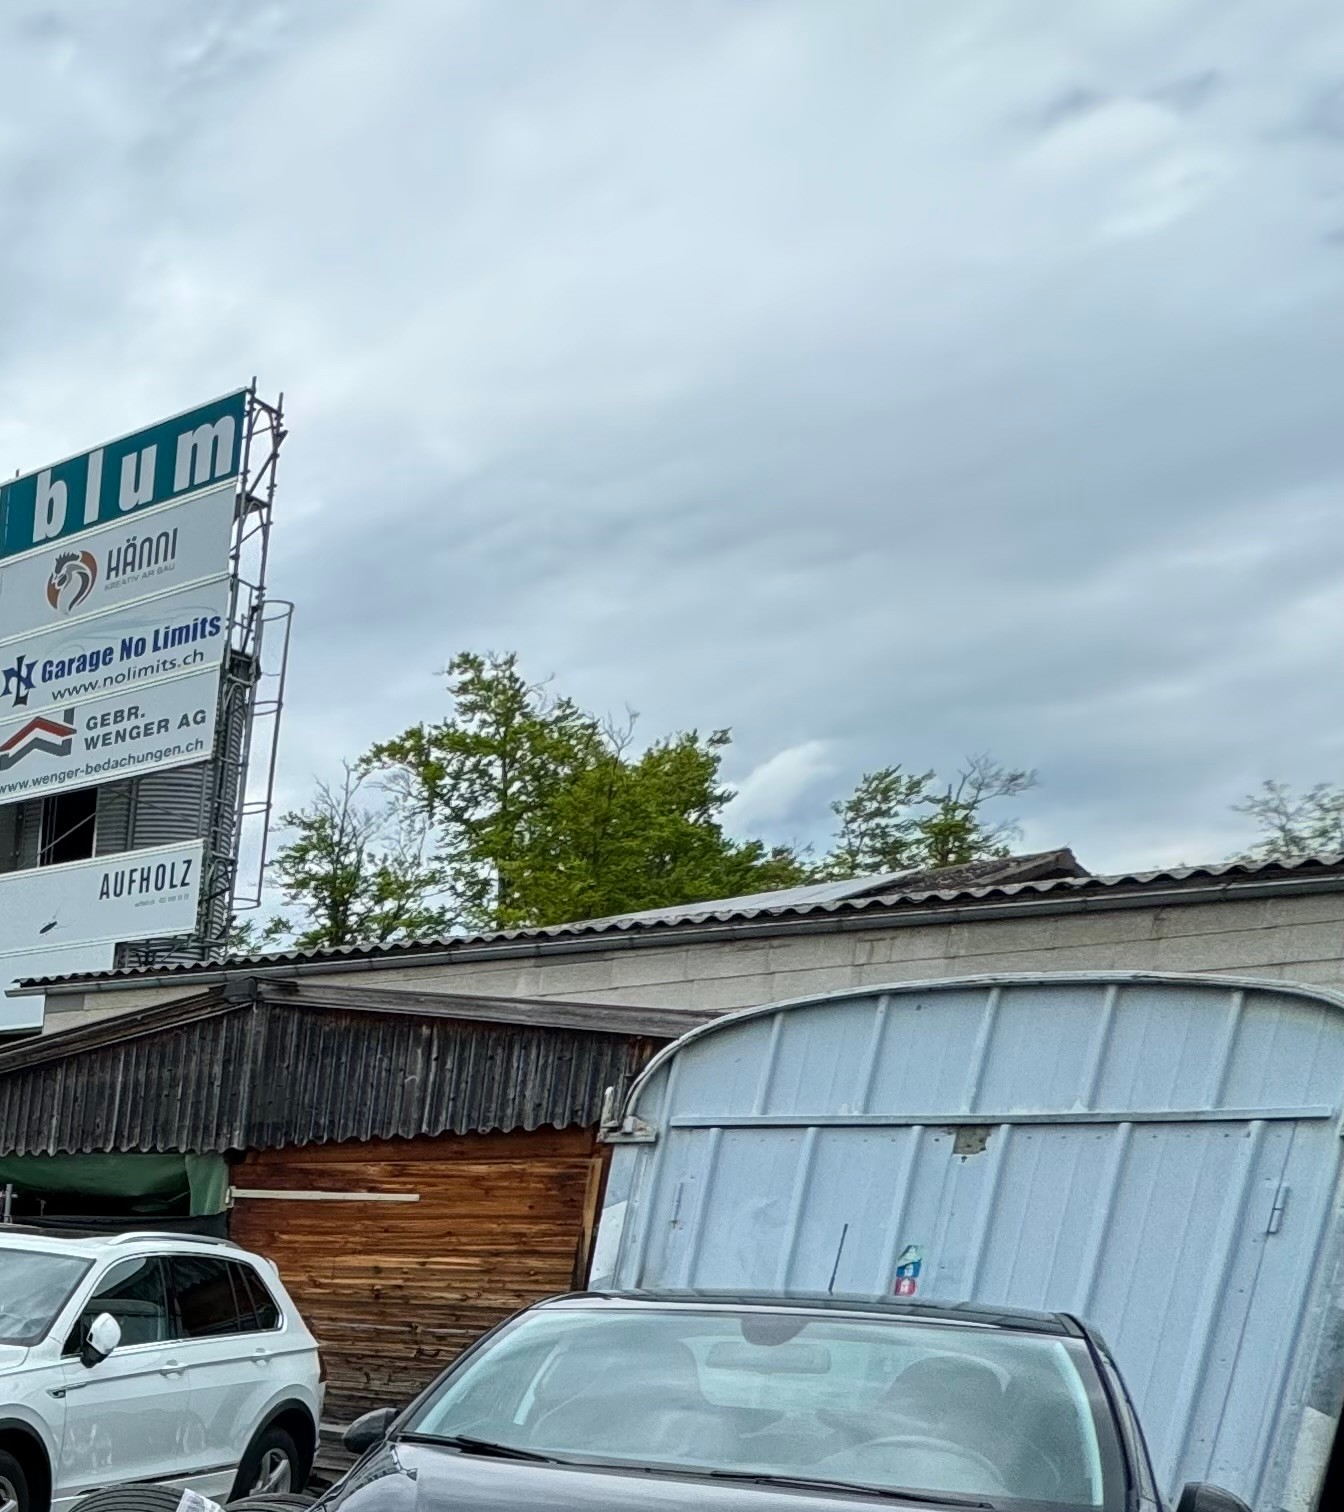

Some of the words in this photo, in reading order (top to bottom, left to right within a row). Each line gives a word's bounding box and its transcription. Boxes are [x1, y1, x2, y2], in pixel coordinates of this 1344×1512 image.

[31, 414, 237, 543] blum
[105, 527, 179, 581] HÄNNI
[41, 645, 114, 684] Garage
[119, 635, 146, 663] No
[151, 615, 222, 653] Limits
[51, 648, 205, 701] www.nolimits.ch
[83, 717, 170, 751] WENGER
[176, 709, 207, 730] AG
[85, 705, 146, 732] GEBR.
[98, 858, 193, 901] AUFHOLZ
